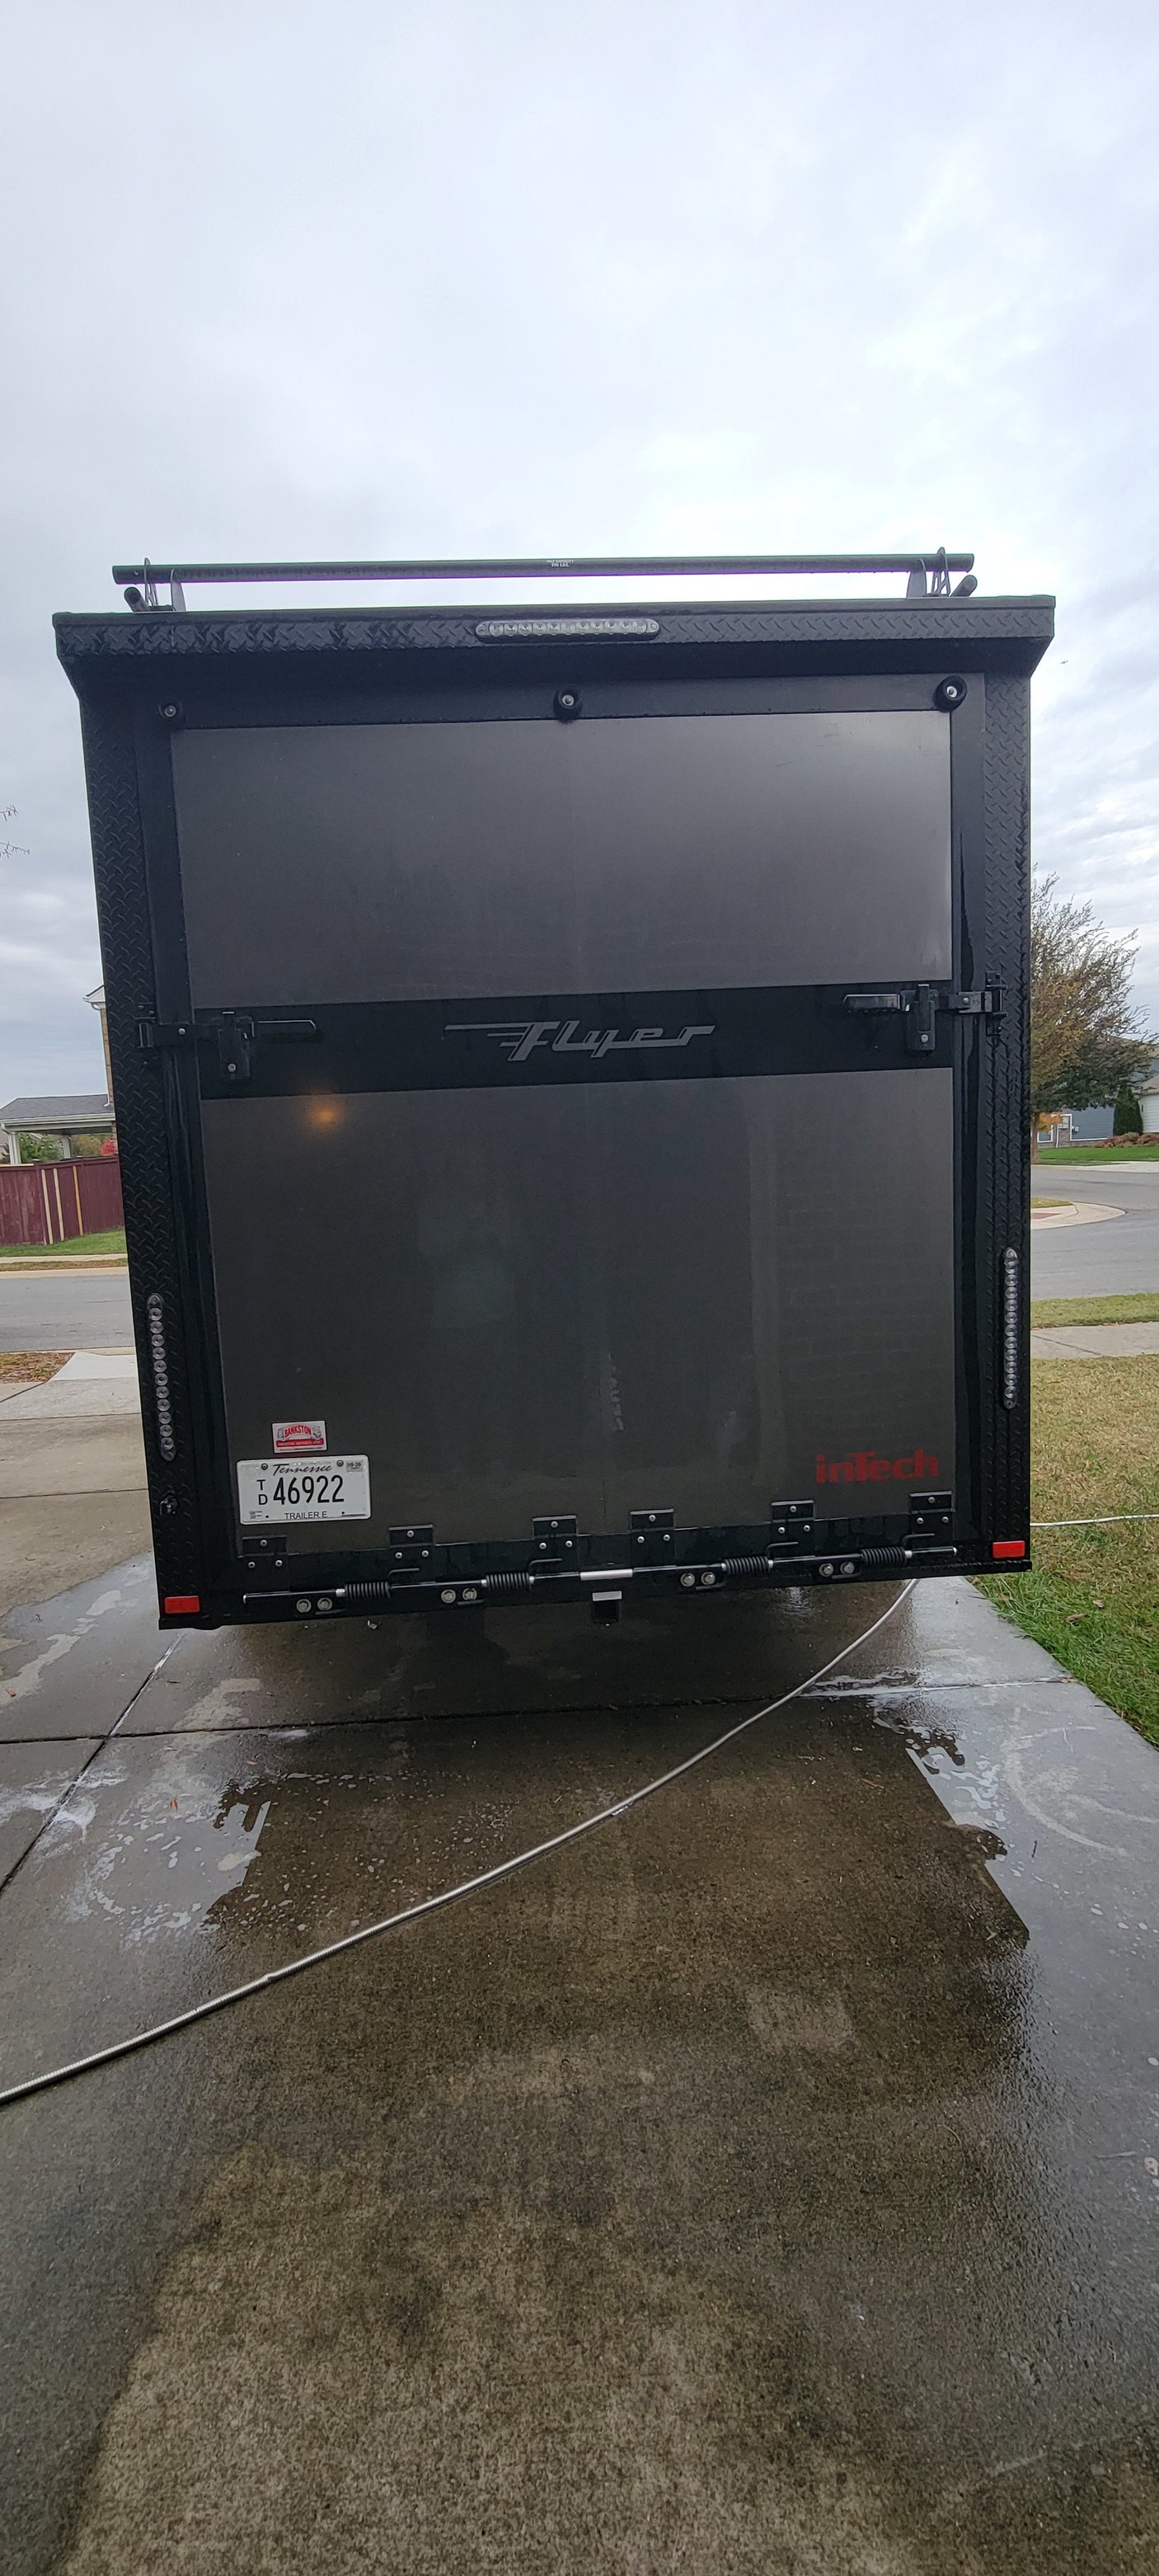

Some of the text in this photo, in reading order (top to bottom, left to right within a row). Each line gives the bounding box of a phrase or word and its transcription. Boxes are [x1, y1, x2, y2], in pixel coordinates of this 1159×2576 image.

[284, 1425, 312, 1437] BANKSTON
[273, 1464, 332, 1476] Tennessee
[815, 1448, 940, 1483] inTech
[256, 1479, 265, 1491] T
[273, 1475, 345, 1505] 46922
[258, 1494, 268, 1506] D
[284, 1511, 320, 1520] TRAILER
